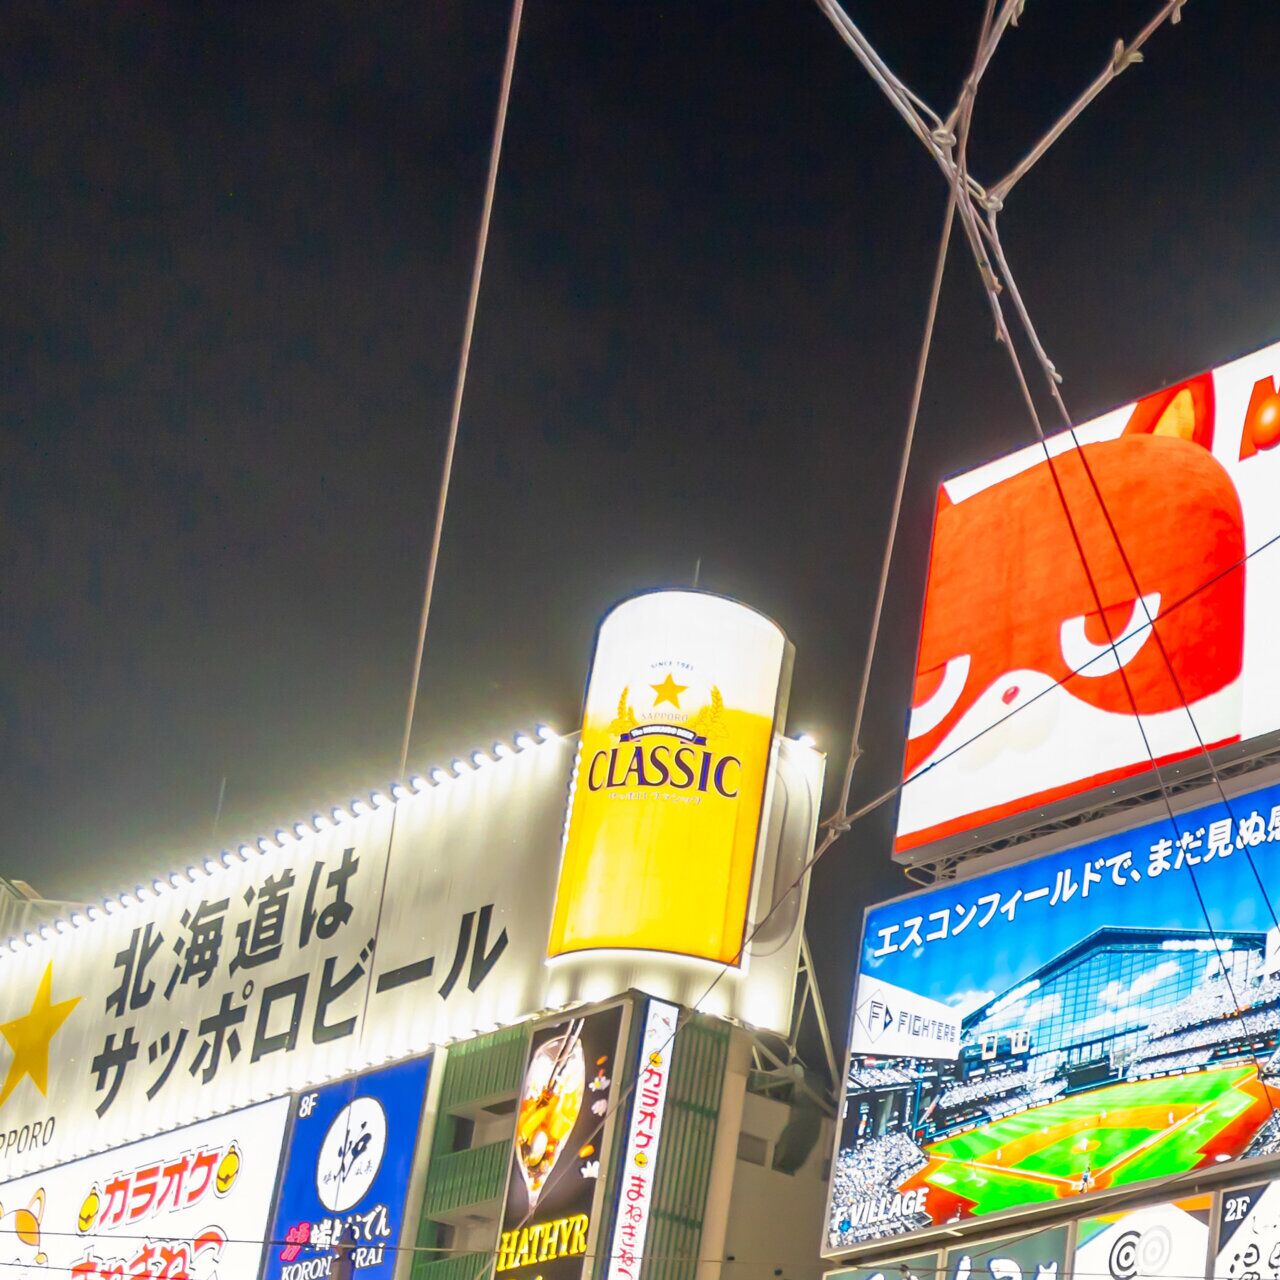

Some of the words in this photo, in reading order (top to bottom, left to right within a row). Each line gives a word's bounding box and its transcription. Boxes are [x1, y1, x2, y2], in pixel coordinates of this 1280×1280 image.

[588, 745, 741, 797] CLASSIC
[105, 847, 361, 1017] 北海道は
[92, 903, 509, 1118] サッポロビール
[898, 1010, 956, 1042] FIGHTERS
[299, 1093, 318, 1118] 8F
[635, 1067, 663, 1150] カラオケ
[101, 1150, 220, 1225] カラオケ
[851, 1187, 930, 1226] VILLAGE
[1224, 1196, 1250, 1221] 2F
[497, 1214, 588, 1271] HATHYR
